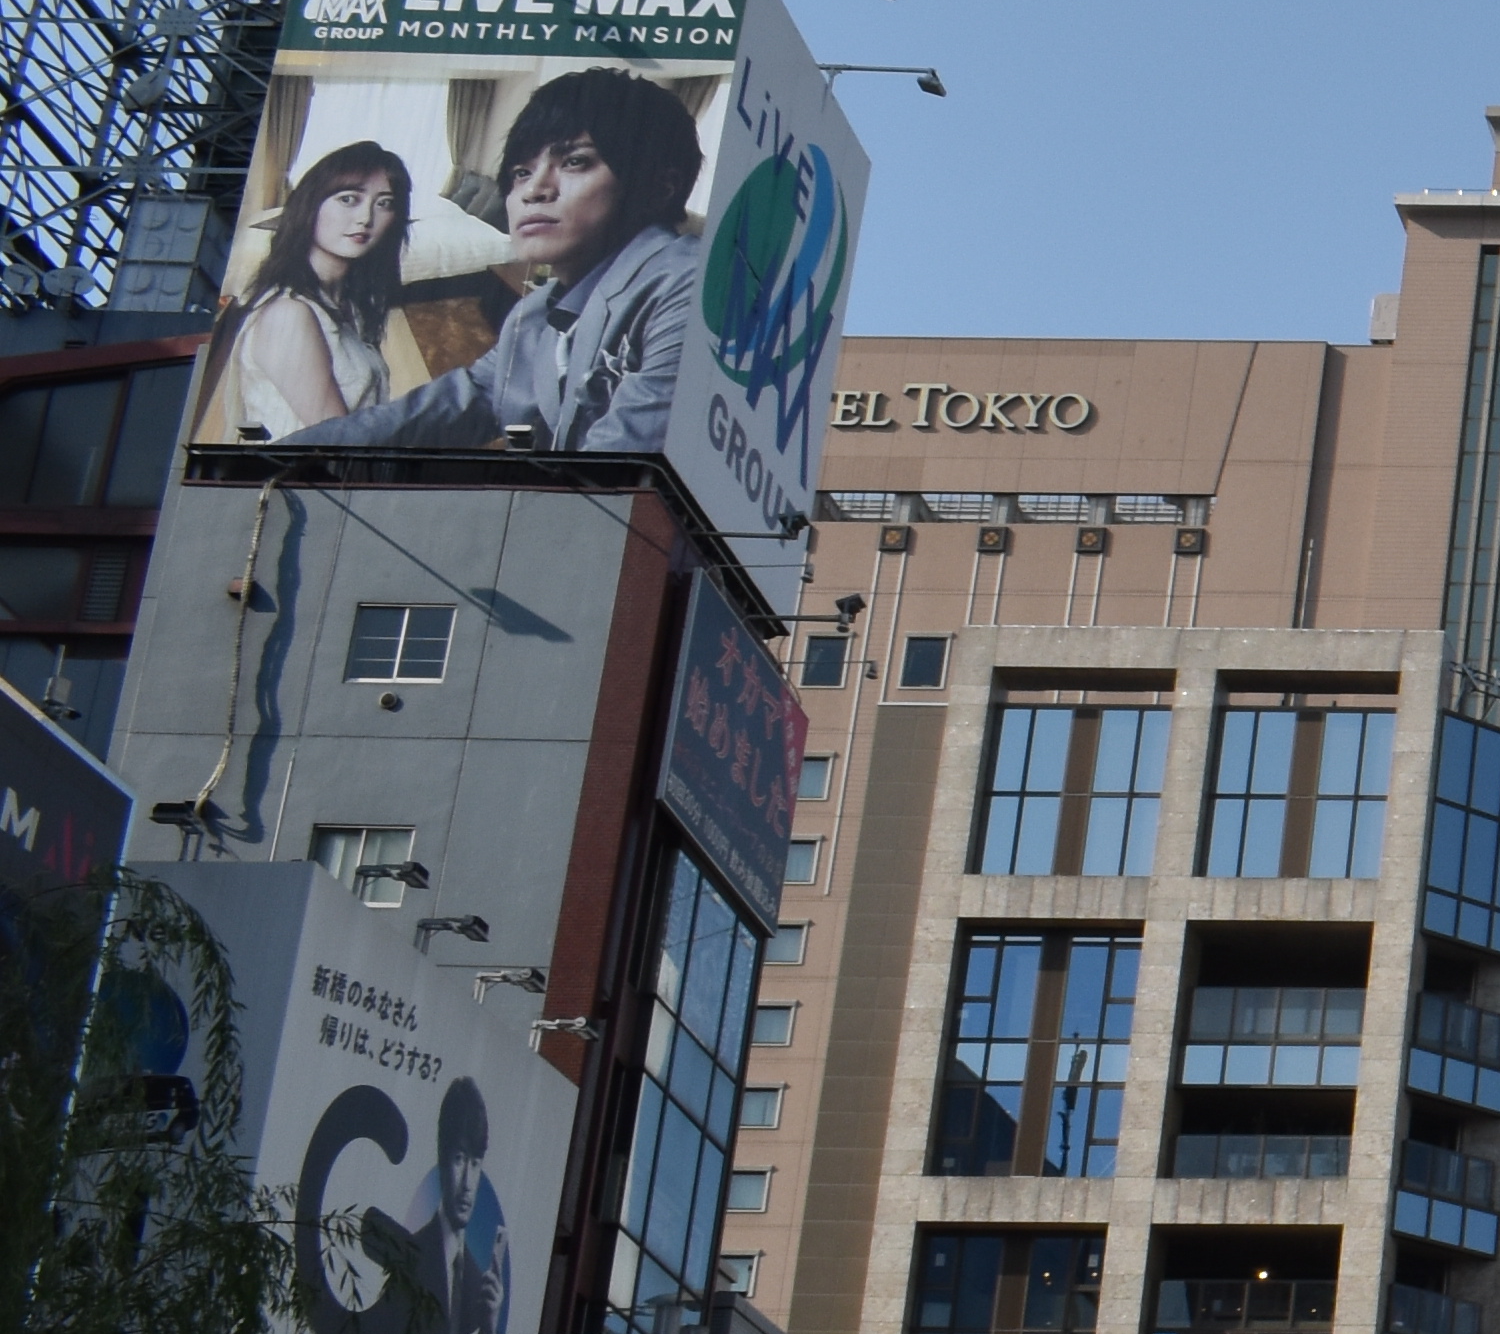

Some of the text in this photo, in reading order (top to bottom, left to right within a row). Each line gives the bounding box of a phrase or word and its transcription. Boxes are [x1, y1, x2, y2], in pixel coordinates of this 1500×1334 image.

[314, 26, 384, 40] GROUP
[398, 20, 734, 46] MONTHLY MANSION
[707, 393, 802, 547] GROU
[311, 963, 418, 1032] 新橋のみなさん
